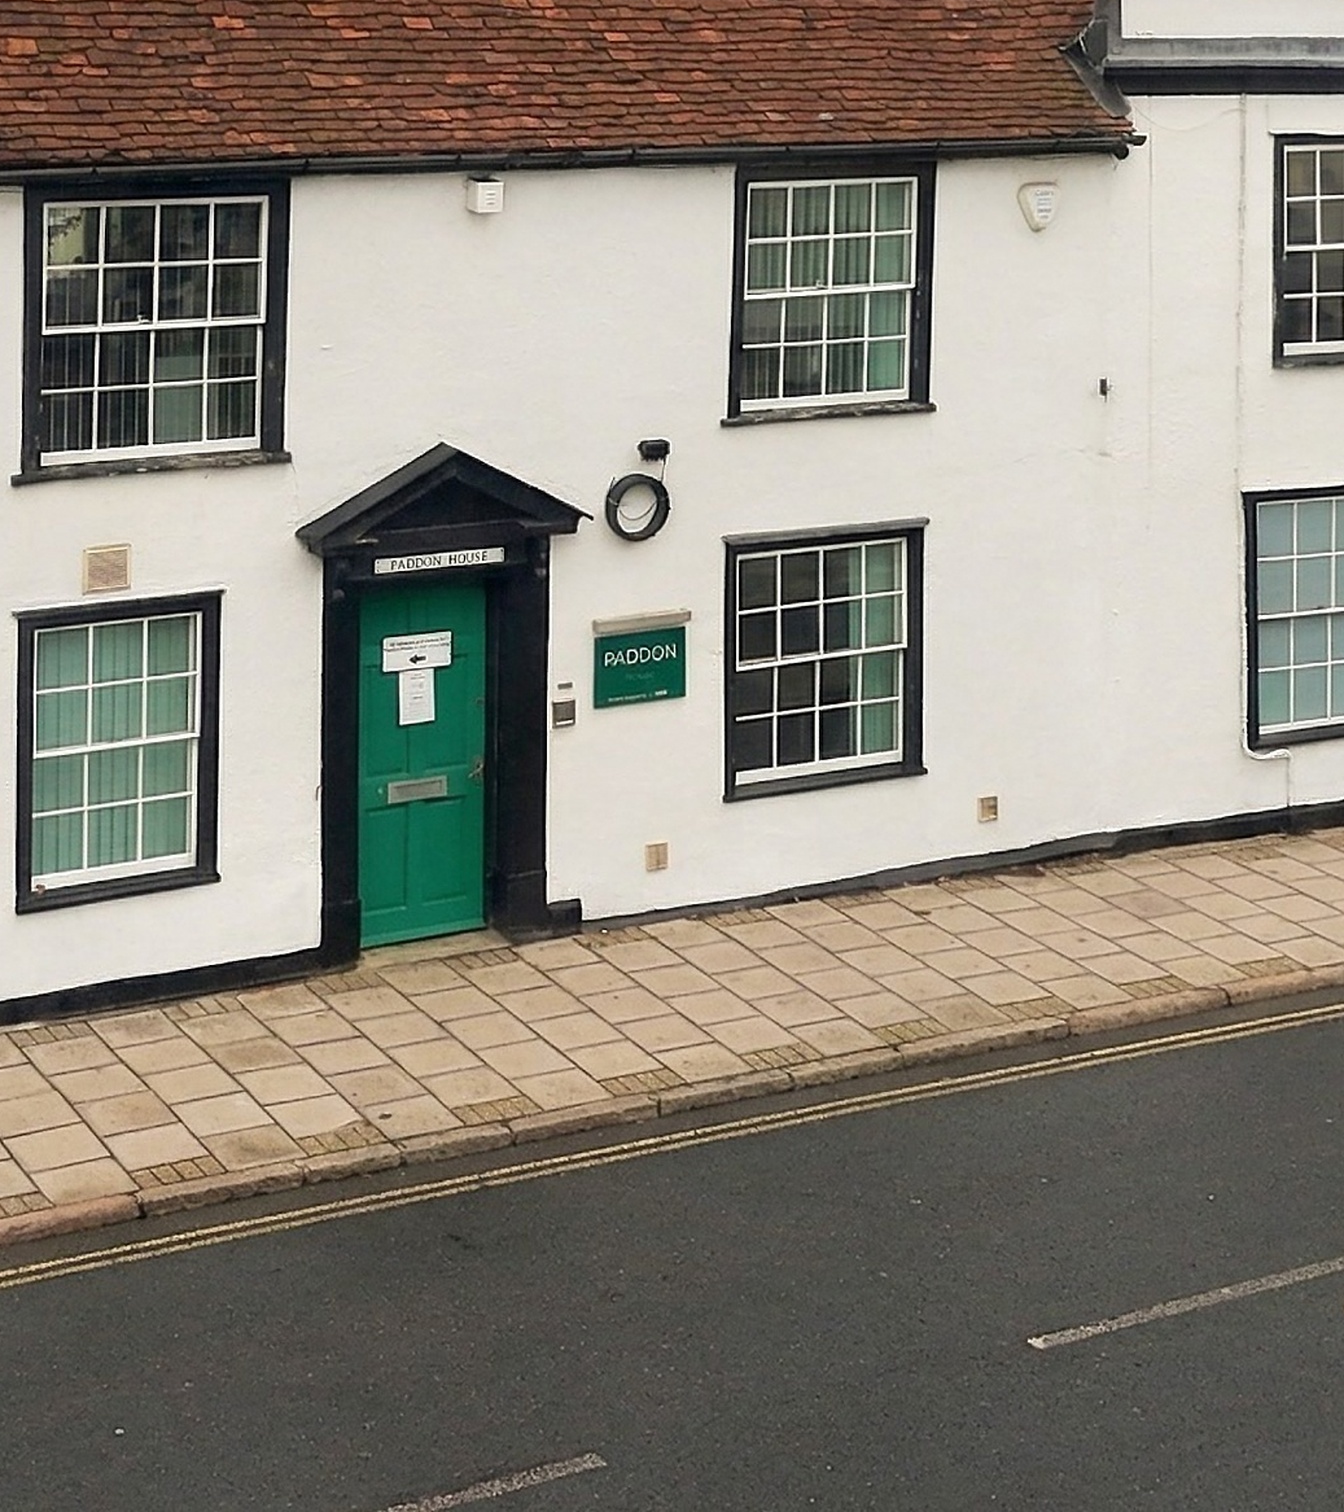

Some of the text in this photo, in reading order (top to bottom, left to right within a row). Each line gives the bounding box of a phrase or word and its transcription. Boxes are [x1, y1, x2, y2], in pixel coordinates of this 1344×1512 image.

[390, 551, 487, 571] PADDON HOUSE
[604, 643, 677, 667] PADDON
